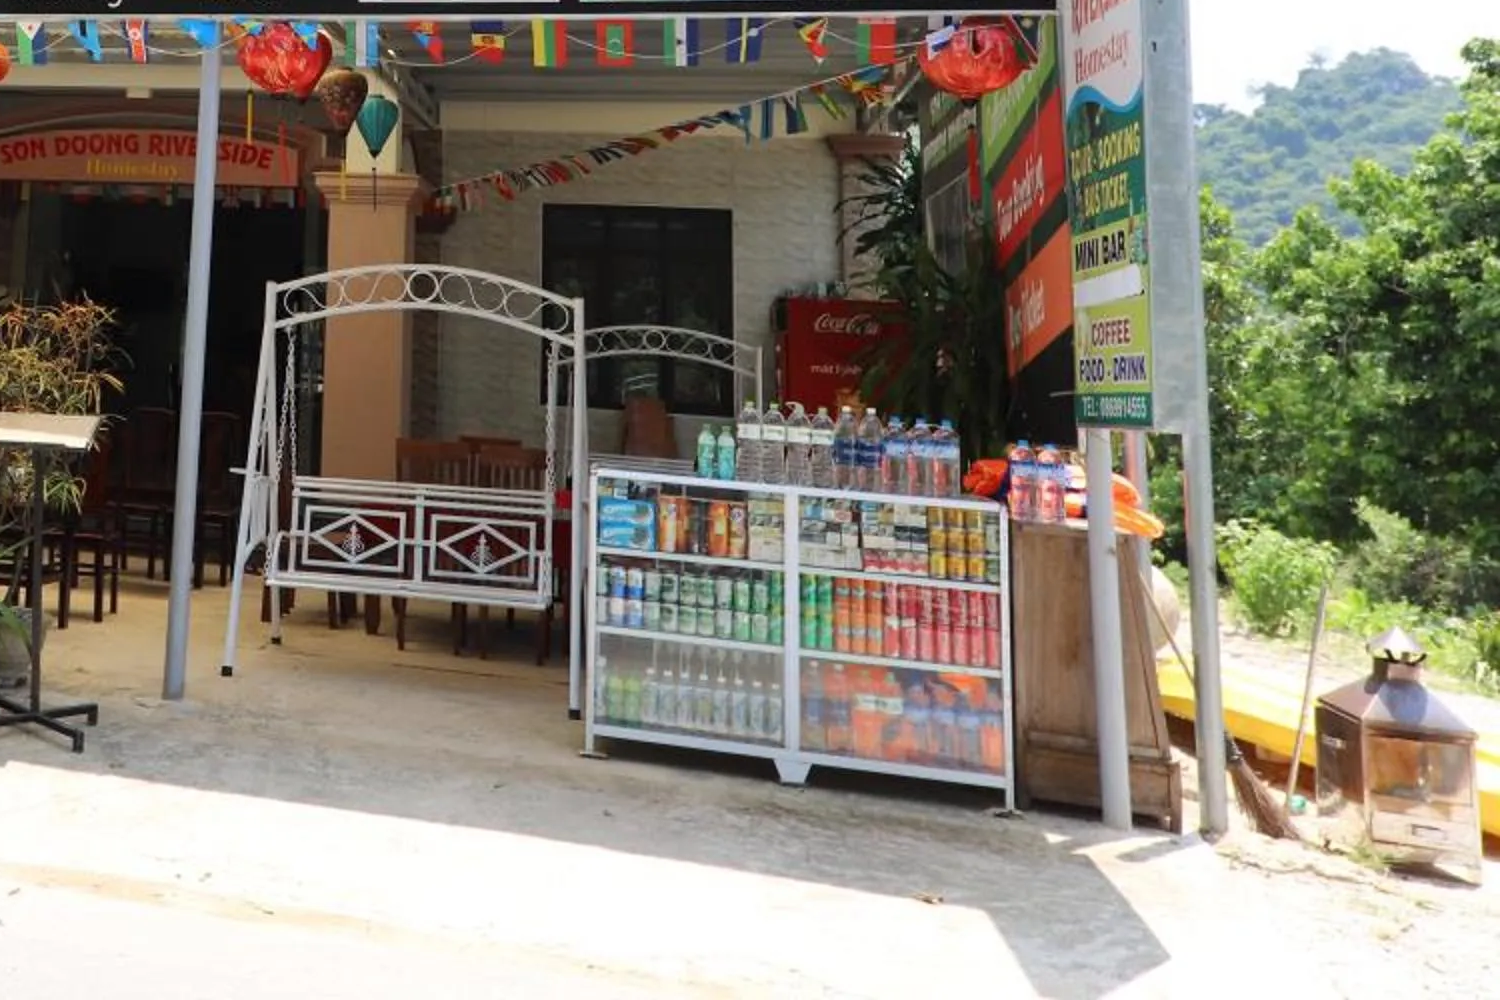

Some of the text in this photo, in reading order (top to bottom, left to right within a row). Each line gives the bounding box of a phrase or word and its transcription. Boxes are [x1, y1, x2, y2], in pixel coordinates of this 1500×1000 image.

[1, 133, 273, 169] SON DOONG RIVESIDE
[1075, 230, 1127, 272] MINI BAR
[1091, 318, 1131, 346] COFFEE
[1079, 357, 1104, 382] FOOD
[1113, 355, 1147, 382] DRINK
